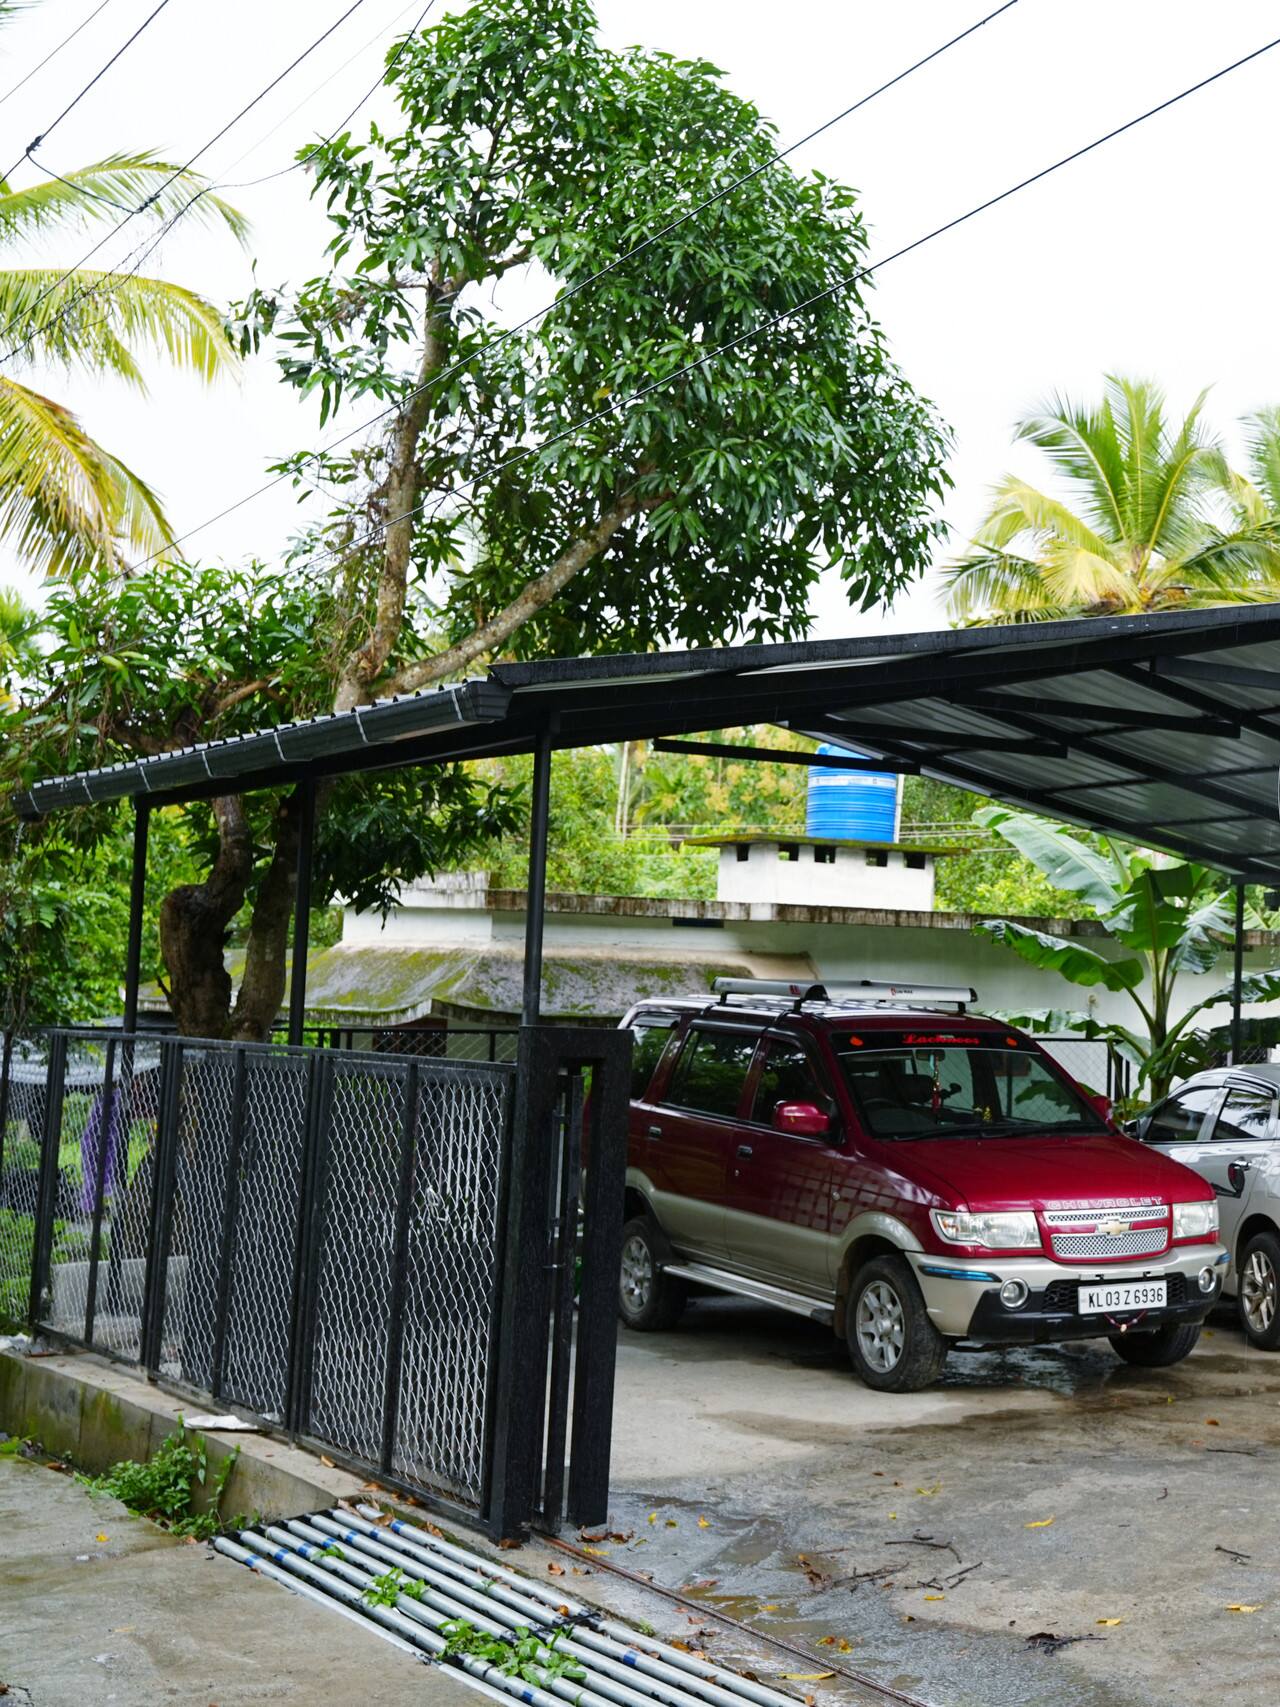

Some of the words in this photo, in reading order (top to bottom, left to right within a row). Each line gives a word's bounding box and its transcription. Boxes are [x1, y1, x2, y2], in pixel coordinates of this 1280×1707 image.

[1048, 1197, 1162, 1210] CHEVROLET
[1124, 1290, 1130, 1305] Z
[1134, 1287, 1163, 1304] 6936
